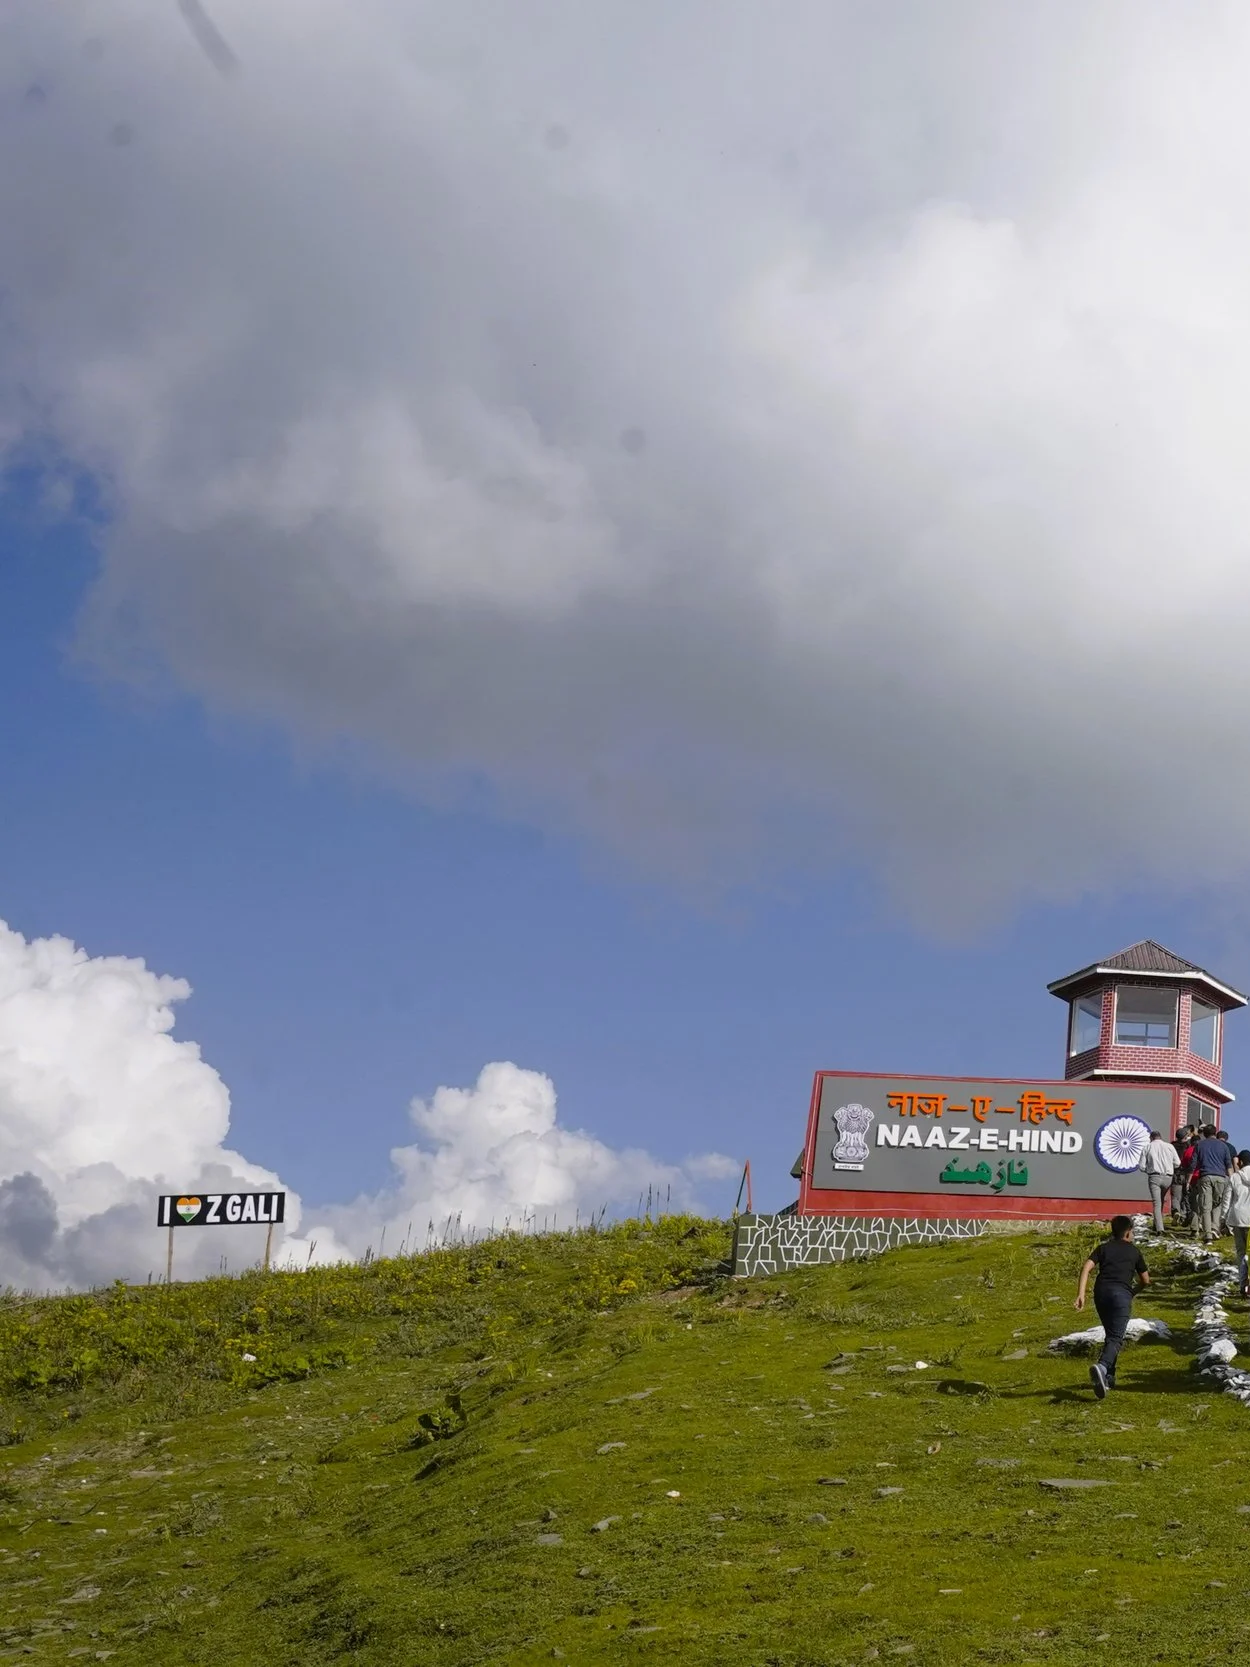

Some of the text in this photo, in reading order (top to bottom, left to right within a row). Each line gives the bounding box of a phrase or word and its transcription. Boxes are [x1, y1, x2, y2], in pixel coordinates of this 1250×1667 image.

[876, 1123, 1083, 1153] NAAZ-E-HIND
[163, 1194, 279, 1224] I Z GALI
